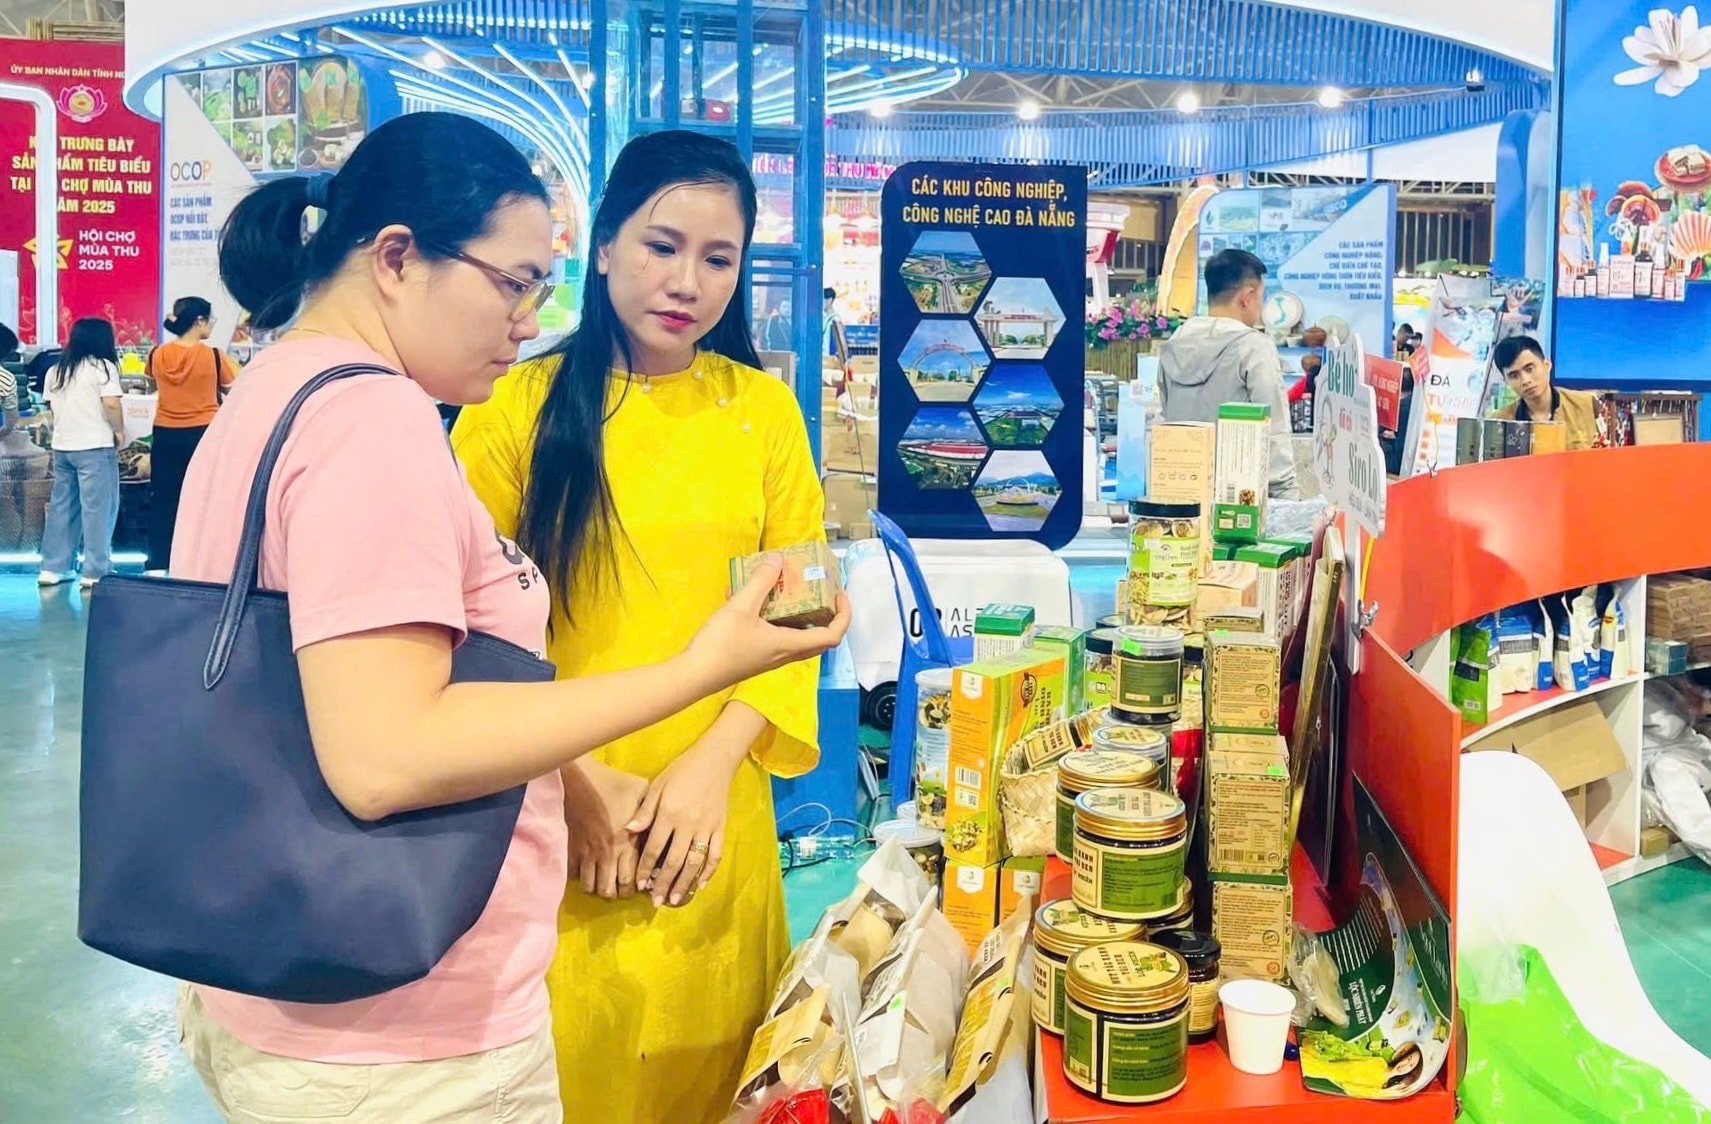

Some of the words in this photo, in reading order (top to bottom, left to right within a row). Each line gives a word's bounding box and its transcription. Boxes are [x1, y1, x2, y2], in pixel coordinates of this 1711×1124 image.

[25, 66, 43, 74] BAN
[45, 66, 70, 76] NHÂN
[72, 68, 90, 77] DÂN
[60, 136, 104, 151] TRƯNG
[108, 136, 134, 152] BÀY
[87, 155, 116, 172] TIÊU
[120, 155, 151, 173] BIỂU
[170, 160, 212, 181] OCOP
[10, 176, 31, 192] TẠI
[61, 178, 89, 195] CHỢ
[92, 177, 122, 193] MÙA
[126, 180, 152, 194] THU
[912, 175, 938, 195] CÁC
[943, 180, 970, 196] KHU
[975, 177, 1010, 198] CÔNG
[1016, 179, 1068, 202] NGHIỆP,
[57, 197, 78, 212] ĂM
[82, 199, 115, 214] 2025
[903, 203, 939, 223] CÔNG
[944, 204, 980, 228] NGHỆ
[984, 209, 1010, 226] CAO
[1016, 206, 1034, 226] ĐÀ
[1038, 203, 1076, 228] NẴNG
[79, 228, 102, 244] HỘI
[106, 230, 136, 243] CHỢ
[79, 243, 109, 256] MÙA
[112, 245, 139, 256] THU
[79, 260, 113, 270] 2025
[1328, 350, 1340, 394] Bé
[1348, 442, 1366, 494] Siro
